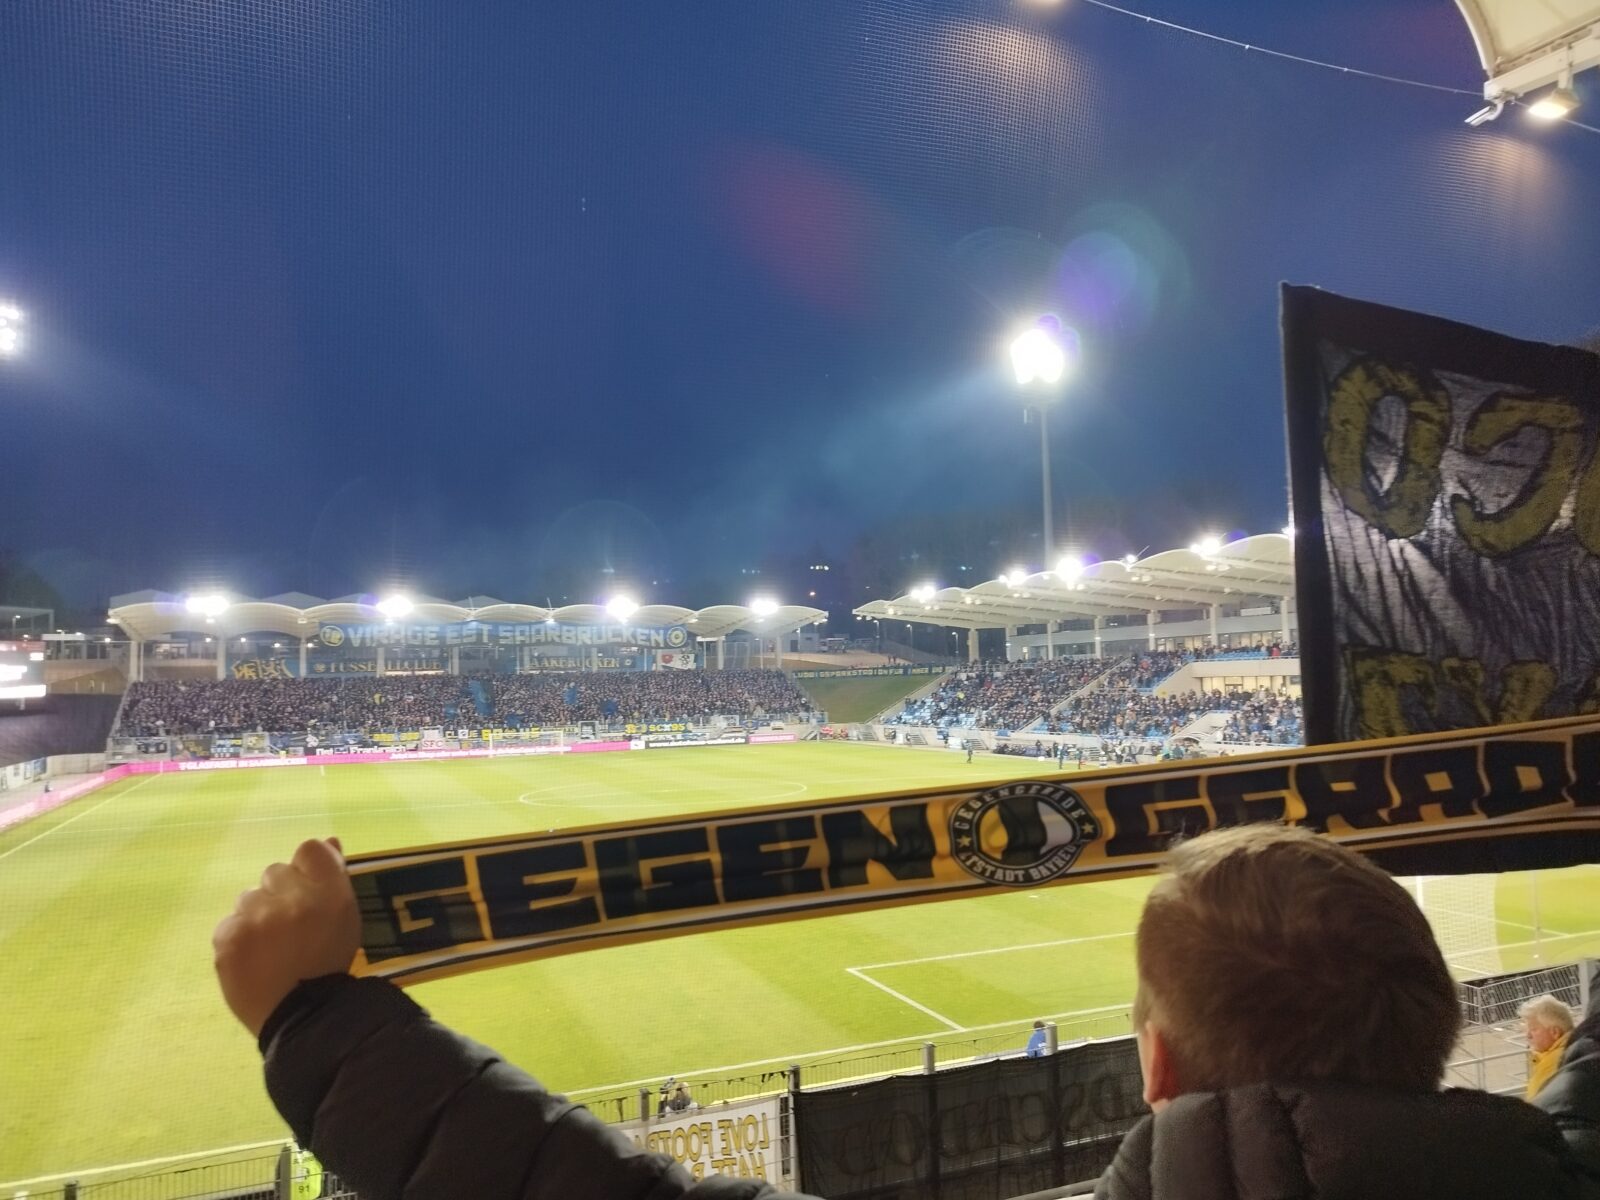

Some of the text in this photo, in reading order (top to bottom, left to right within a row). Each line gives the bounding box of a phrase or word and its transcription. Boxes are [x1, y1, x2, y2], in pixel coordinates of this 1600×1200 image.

[347, 623, 440, 647] VIRAGE
[446, 622, 492, 645] EST
[954, 784, 1087, 831] GEGENGERADE
[350, 802, 936, 964] GEGEN
[957, 843, 1077, 882] TSTADT BAYREU
